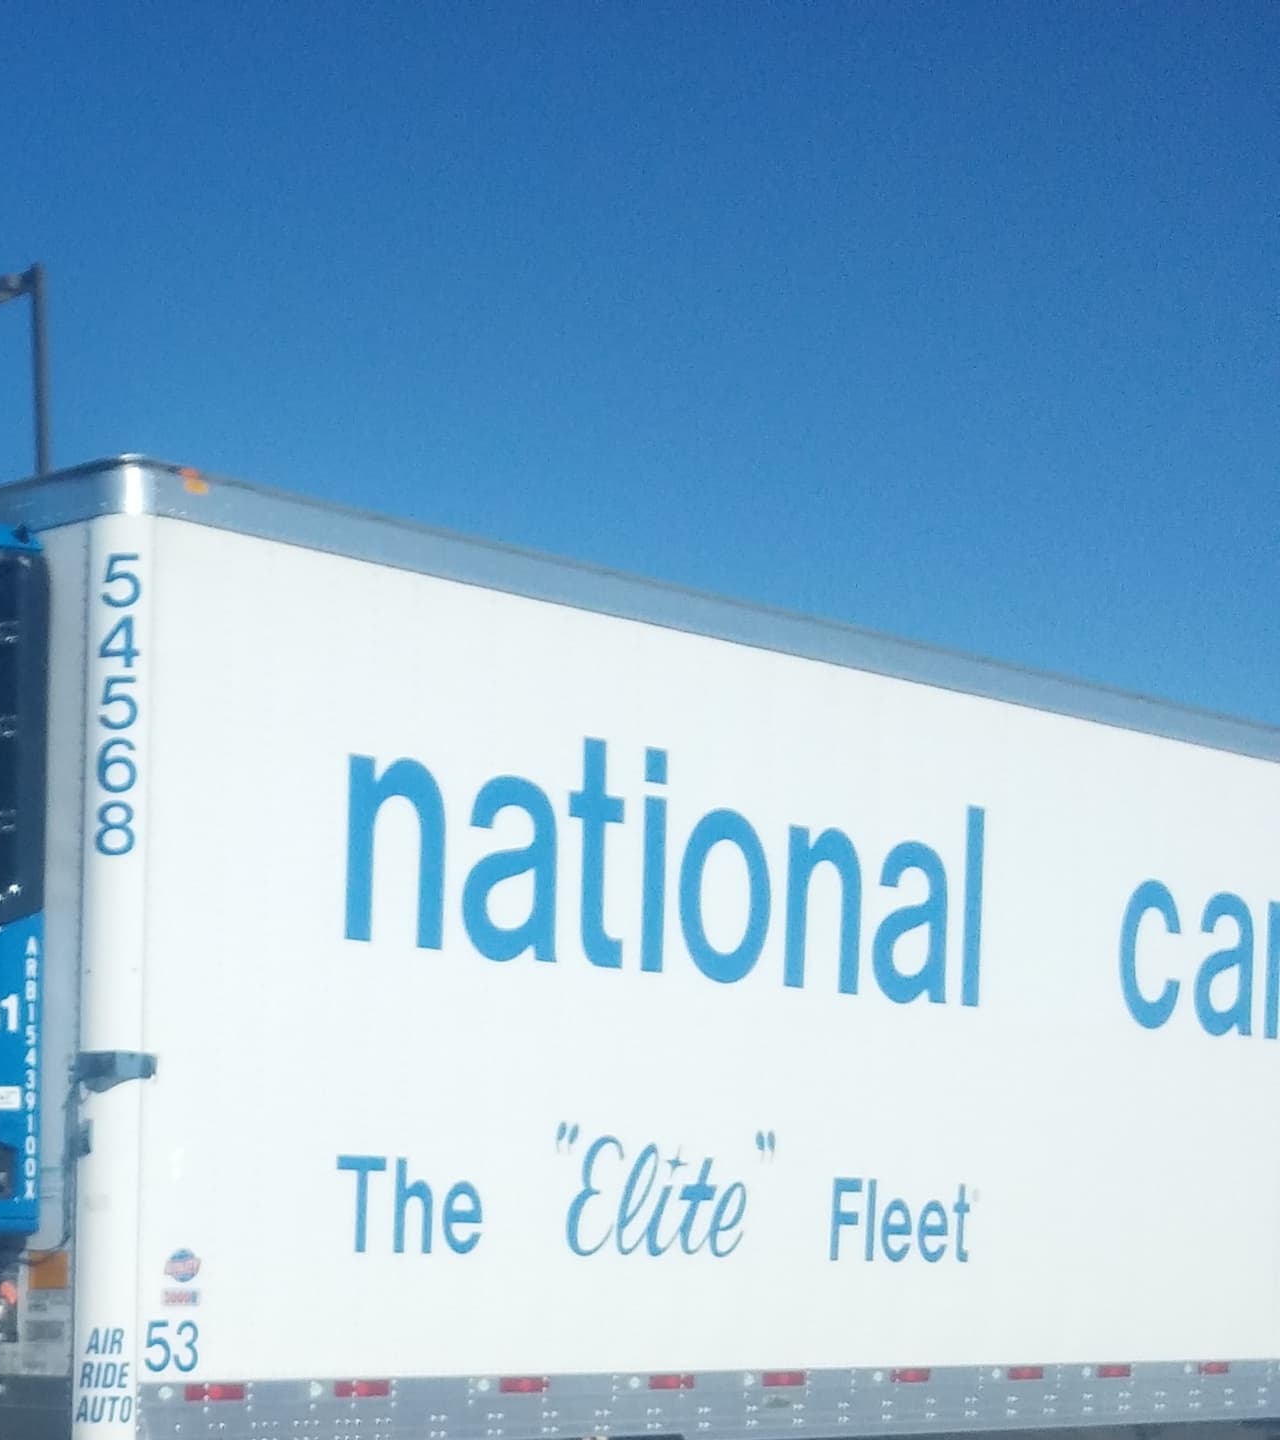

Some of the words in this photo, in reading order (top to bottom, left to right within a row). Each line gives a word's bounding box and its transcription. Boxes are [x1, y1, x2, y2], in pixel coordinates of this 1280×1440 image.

[94, 553, 141, 856] 54568
[343, 737, 986, 1008] national
[336, 1153, 483, 1255] The
[829, 1176, 973, 1264] Fleet
[85, 1327, 124, 1355] AIR
[144, 1319, 199, 1373] 53
[79, 1361, 130, 1390] RIDE
[75, 1395, 133, 1424] AUTO
